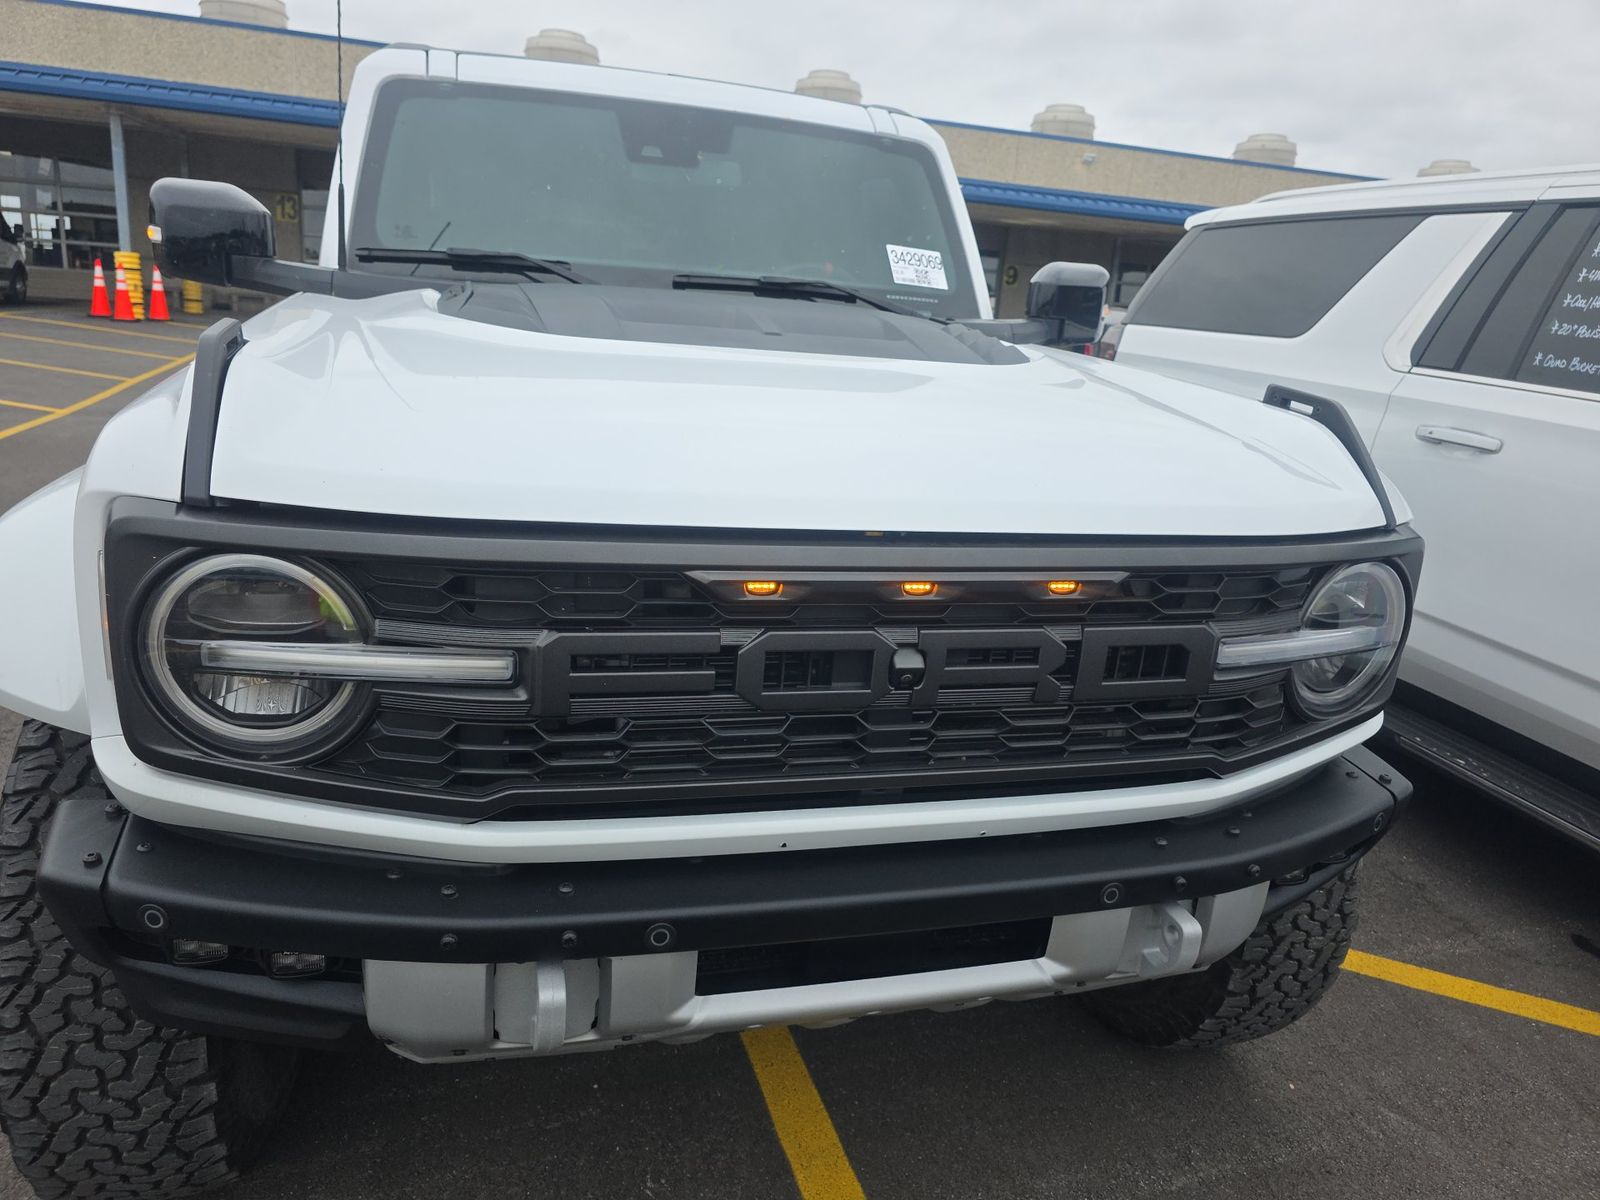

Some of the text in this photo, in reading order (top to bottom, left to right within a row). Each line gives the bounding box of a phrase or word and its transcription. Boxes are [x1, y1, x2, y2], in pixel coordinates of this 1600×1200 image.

[277, 195, 297, 219] 13
[891, 249, 943, 270] 3429069
[1005, 265, 1018, 286] 9
